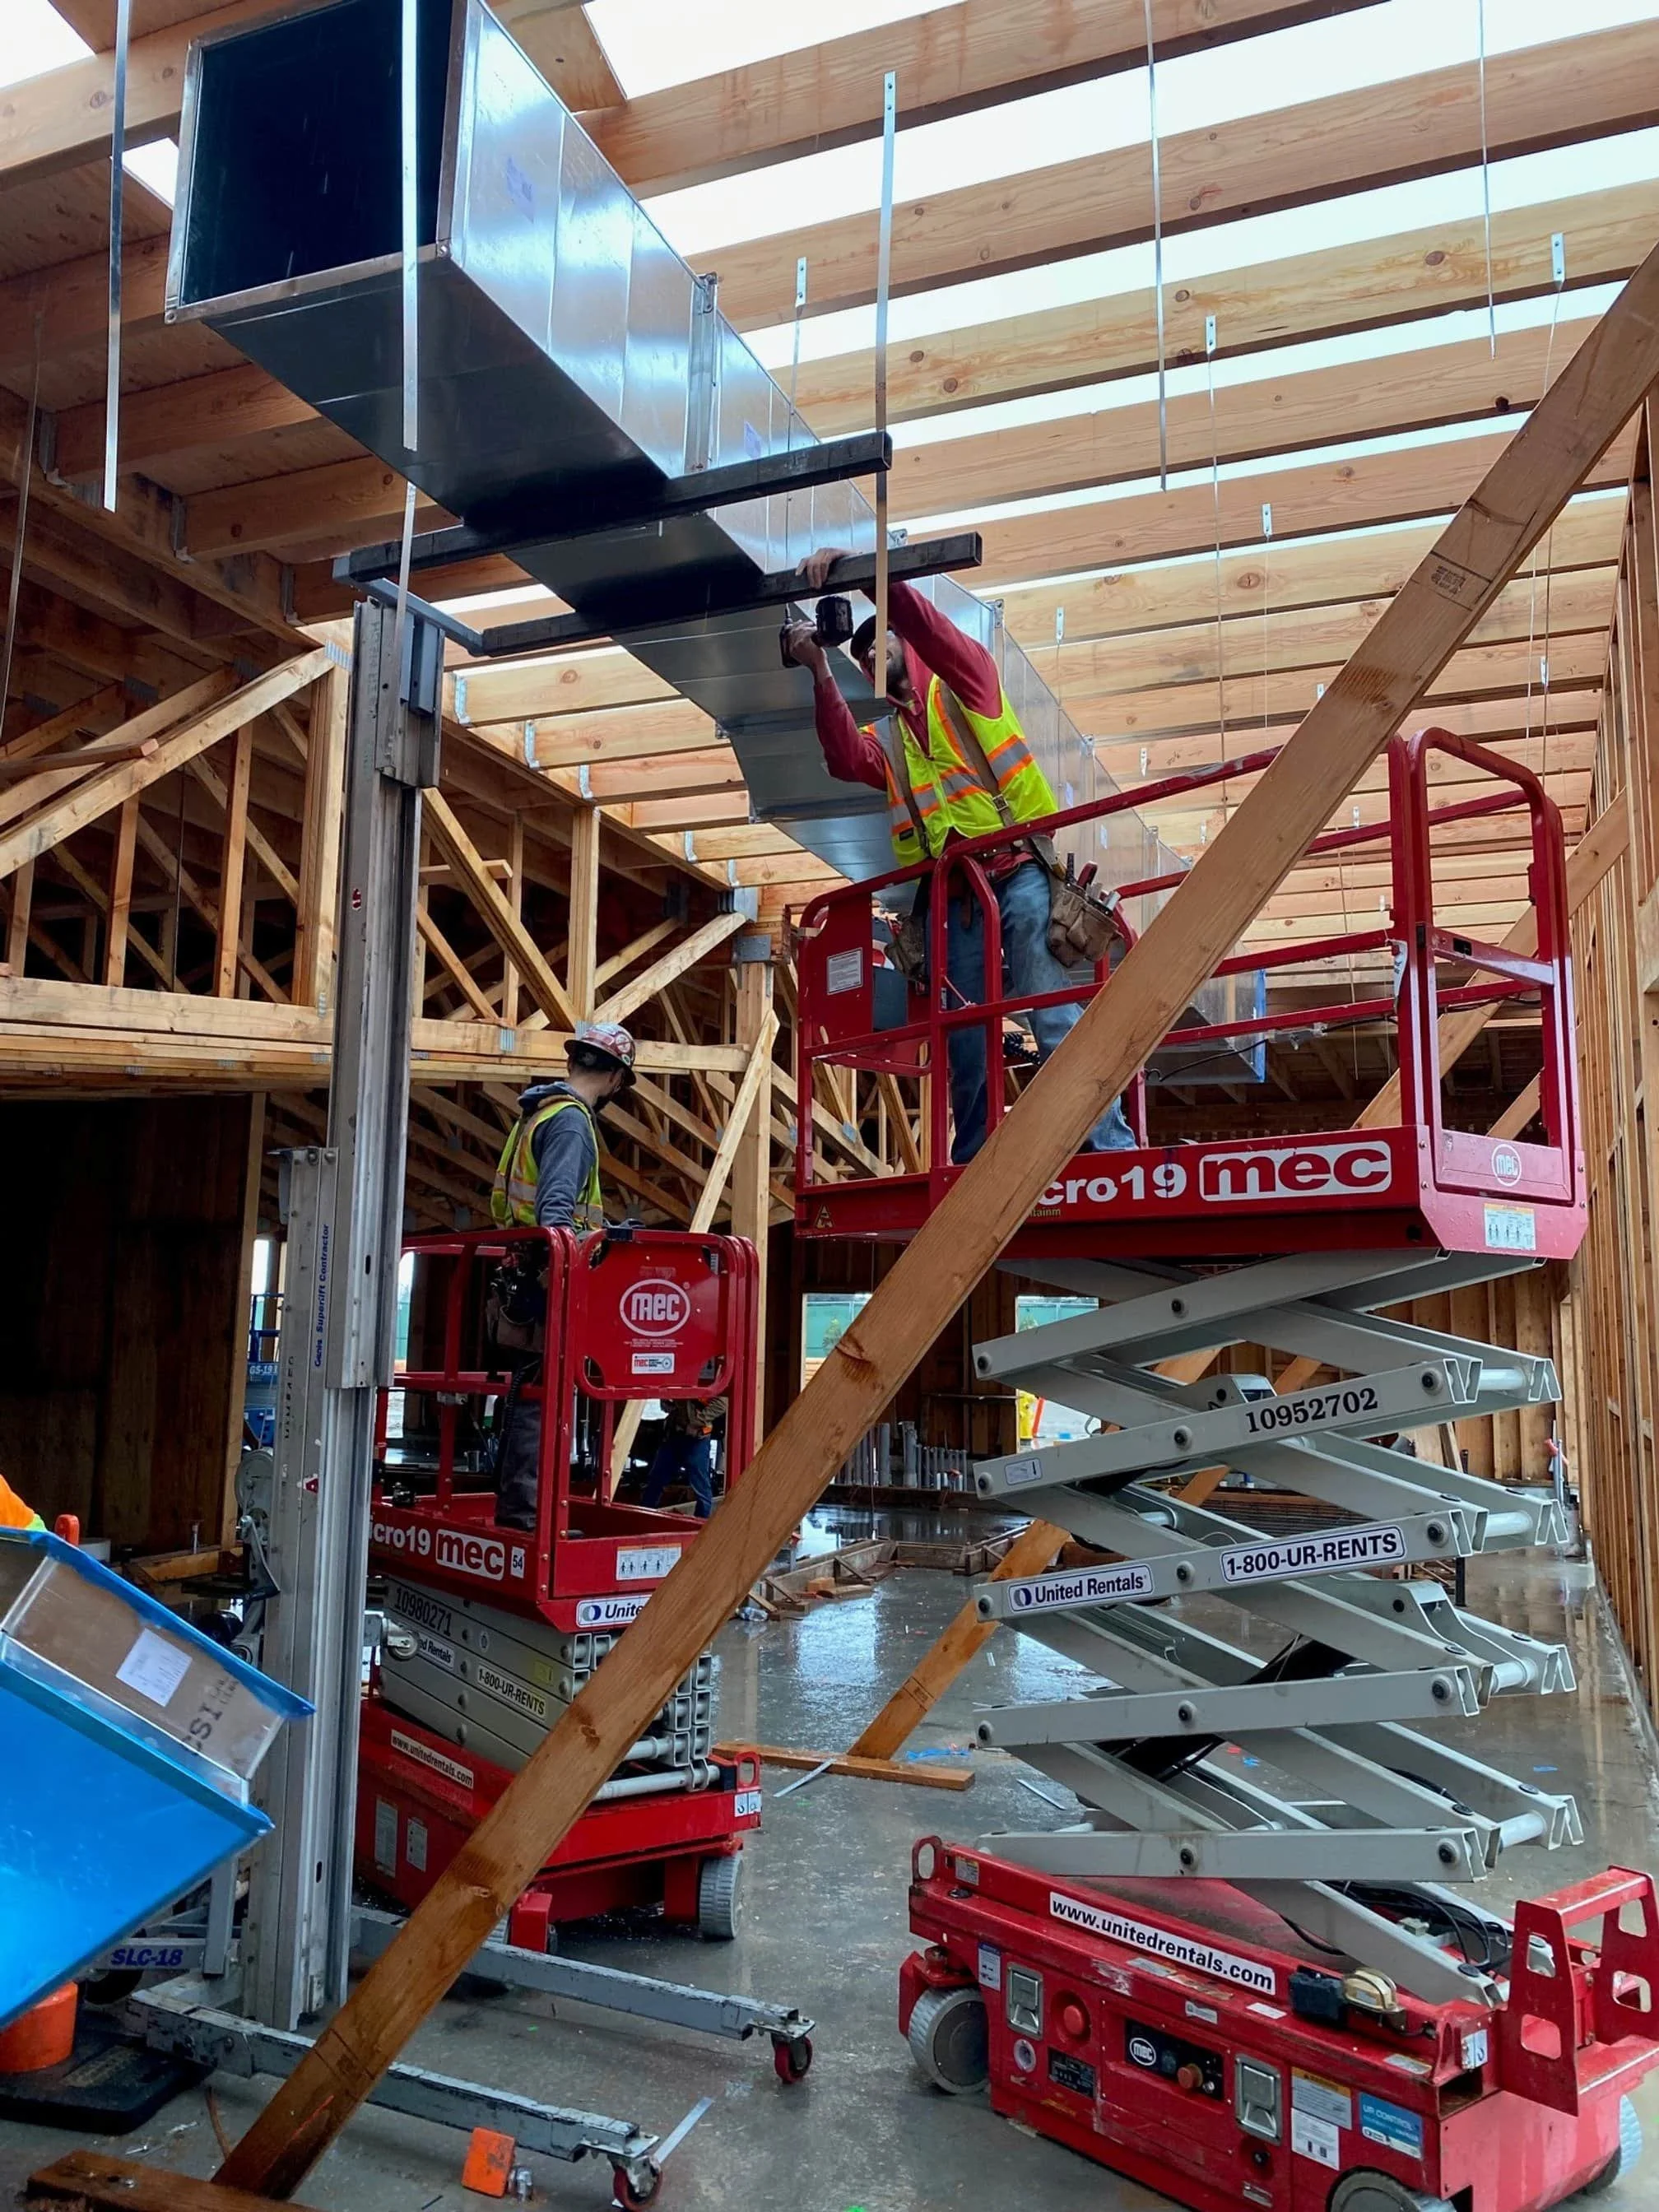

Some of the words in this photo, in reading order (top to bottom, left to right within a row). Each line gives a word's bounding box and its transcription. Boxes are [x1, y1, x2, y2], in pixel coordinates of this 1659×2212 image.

[1038, 1163, 1187, 1206] cro19
[1204, 1148, 1389, 1196] mec
[318, 1224, 329, 1281] Contractor
[1246, 1387, 1378, 1433] 10952702
[437, 1531, 504, 1575] mec
[513, 1554, 523, 1570] 54
[1226, 1533, 1397, 1575] 1-800-UR-RENTS
[1034, 1581, 1083, 1604] United
[1087, 1573, 1144, 1596] Rentals
[396, 1587, 451, 1637] 10980271
[478, 1668, 546, 1715] 1-800-UR-RENTS
[393, 1736, 473, 1787] www.unitedrentals.com
[111, 1949, 184, 1966] SLC-18
[1052, 1900, 1273, 1990] www.unitedrentals.com
